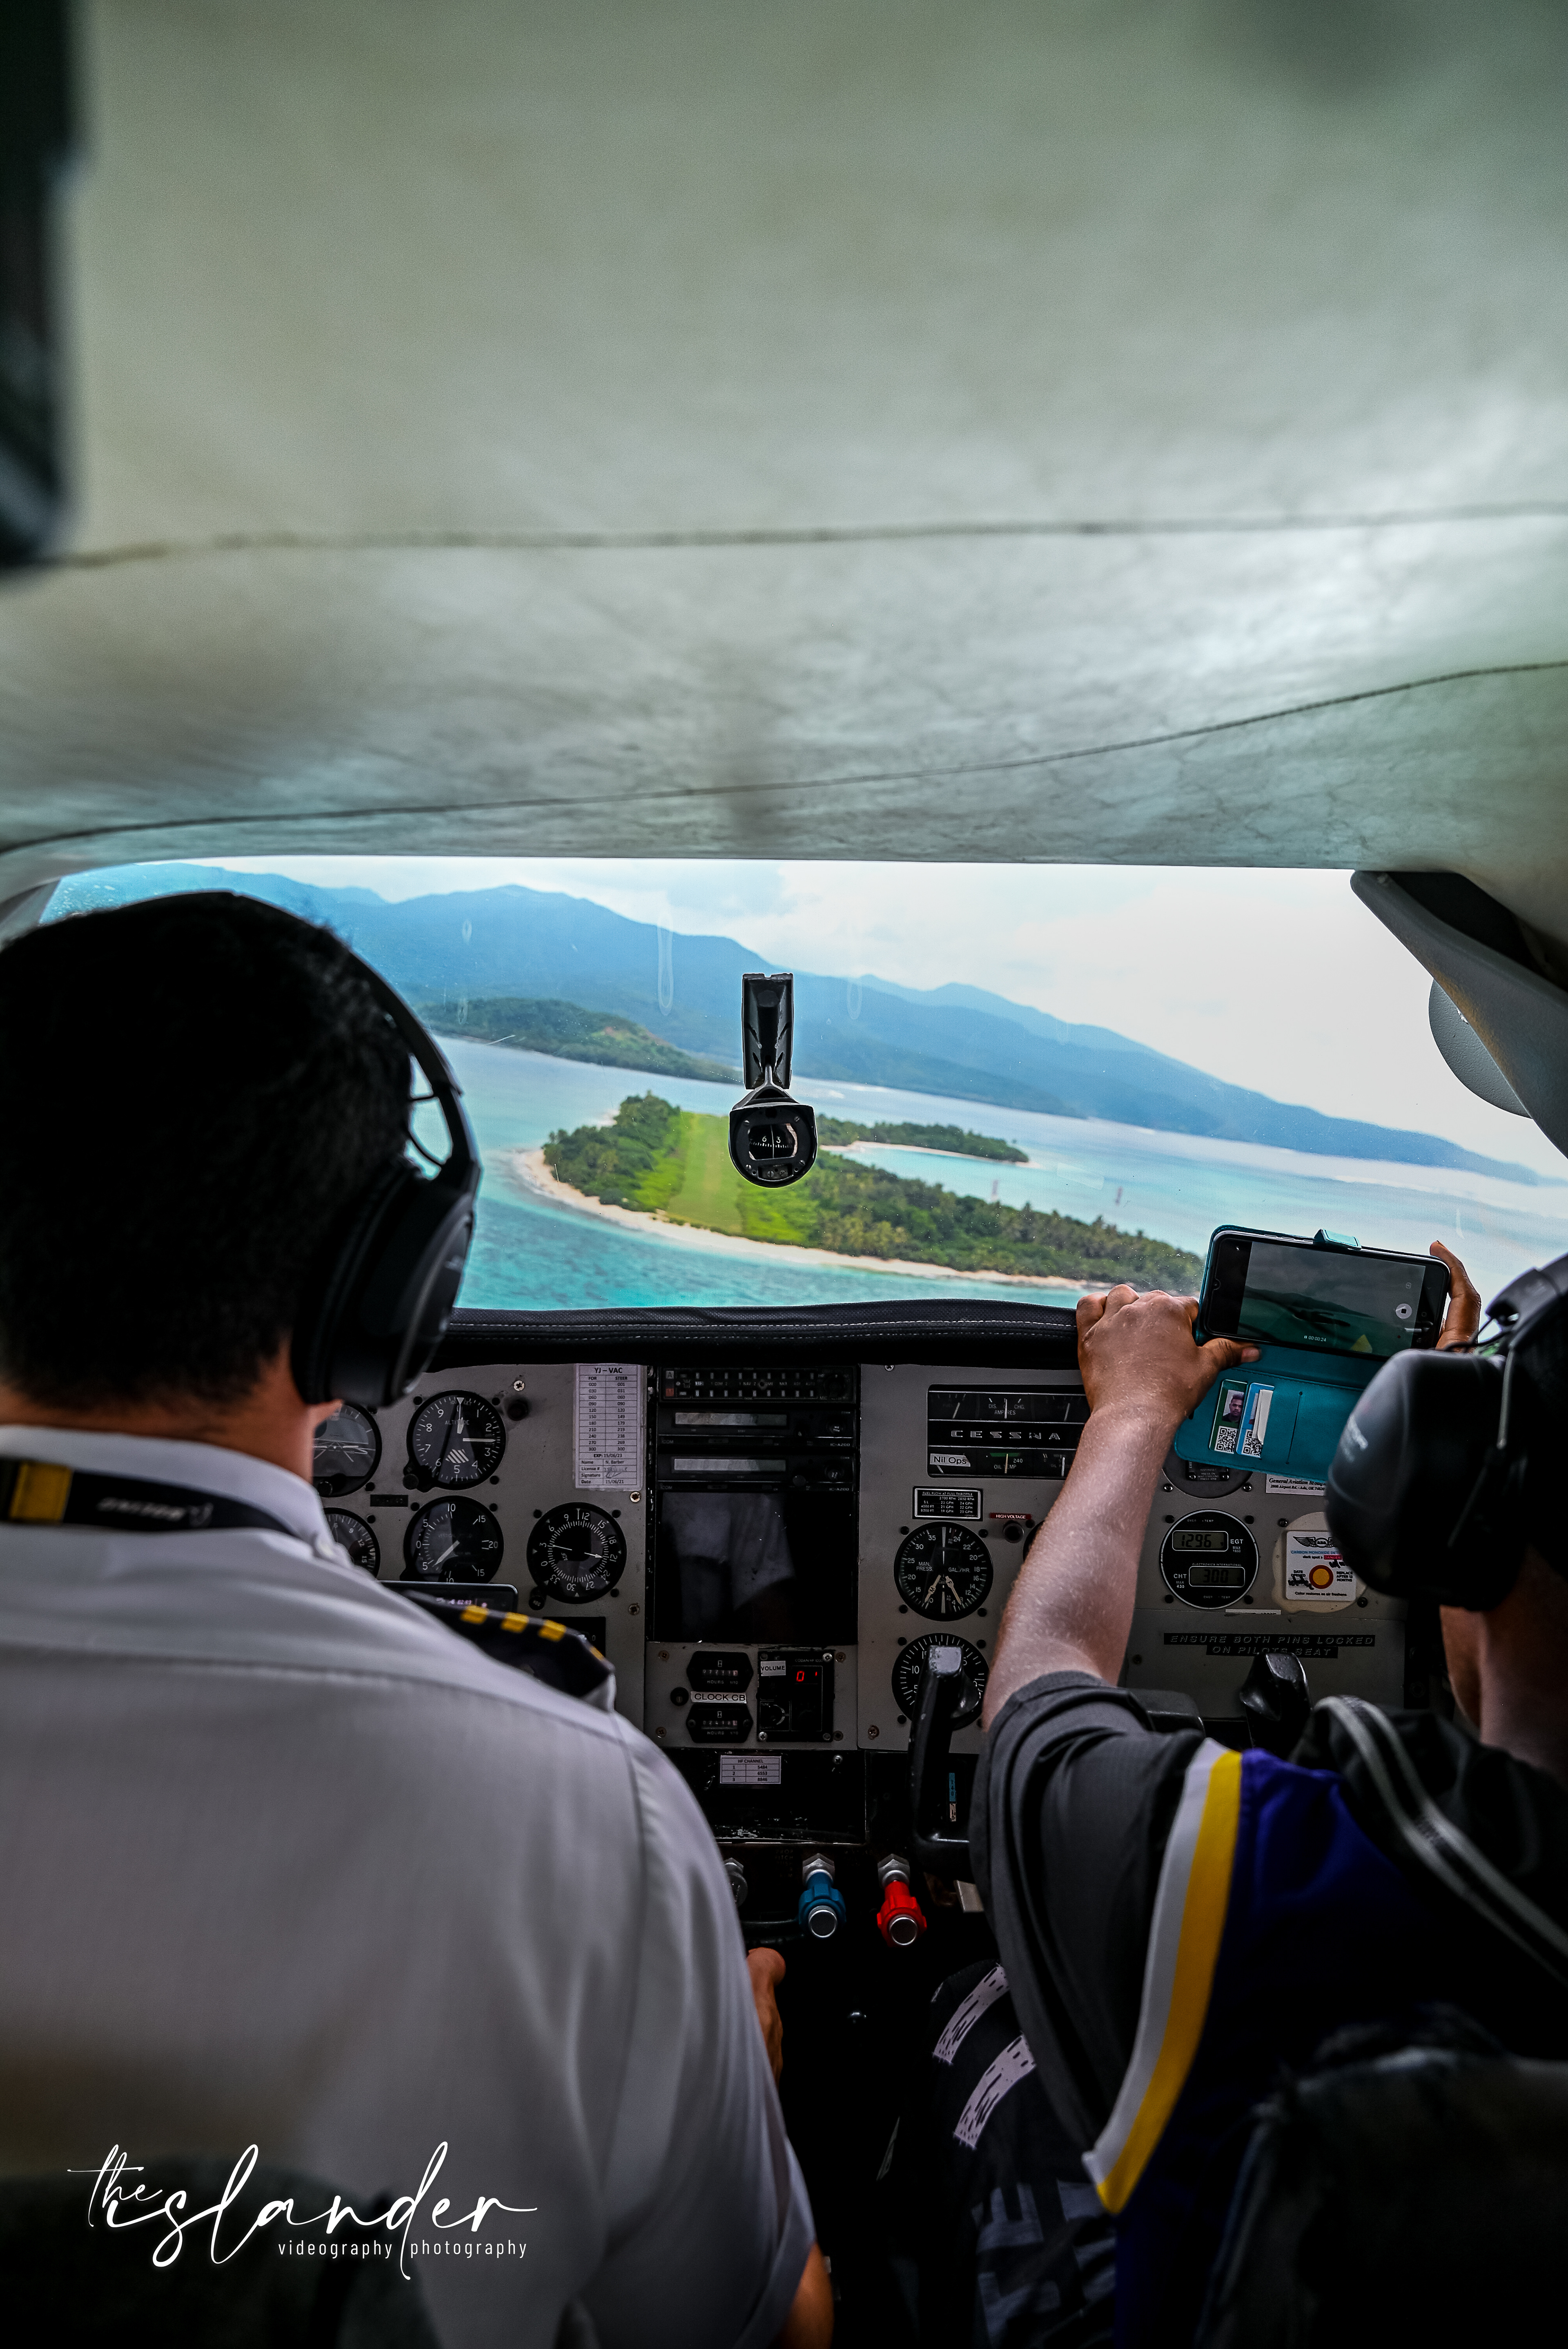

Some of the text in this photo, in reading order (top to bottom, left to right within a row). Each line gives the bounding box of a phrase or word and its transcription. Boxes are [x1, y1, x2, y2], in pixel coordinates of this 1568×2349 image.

[438, 1409, 444, 1418] 9
[426, 1423, 432, 1432] 8
[486, 1423, 492, 1432] 2
[951, 1430, 1060, 1440] CESSNA
[425, 1444, 431, 1453] 7
[484, 1447, 490, 1457] 3
[435, 1458, 441, 1466] 6
[472, 1460, 478, 1469] 4
[454, 1465, 460, 1473] 5
[448, 1503, 456, 1512] 10
[582, 1512, 590, 1520] 12
[423, 1519, 429, 1527] 5
[598, 1520, 606, 1529] 15
[358, 1539, 365, 1547] 12
[416, 1540, 421, 1549] 0
[608, 1536, 617, 1544] 18
[1181, 1534, 1212, 1547] 1296
[609, 1554, 618, 1562] 21
[422, 1562, 428, 1570] 5
[601, 1569, 610, 1580] 24
[1203, 1569, 1229, 1583] 300
[550, 1574, 560, 1585] 33
[567, 1583, 577, 1591] 30
[586, 1581, 595, 1590] 27
[1316, 1636, 1373, 1645] LOCKED
[1294, 1647, 1331, 1656] SEAT
[912, 1665, 920, 1674] 10
